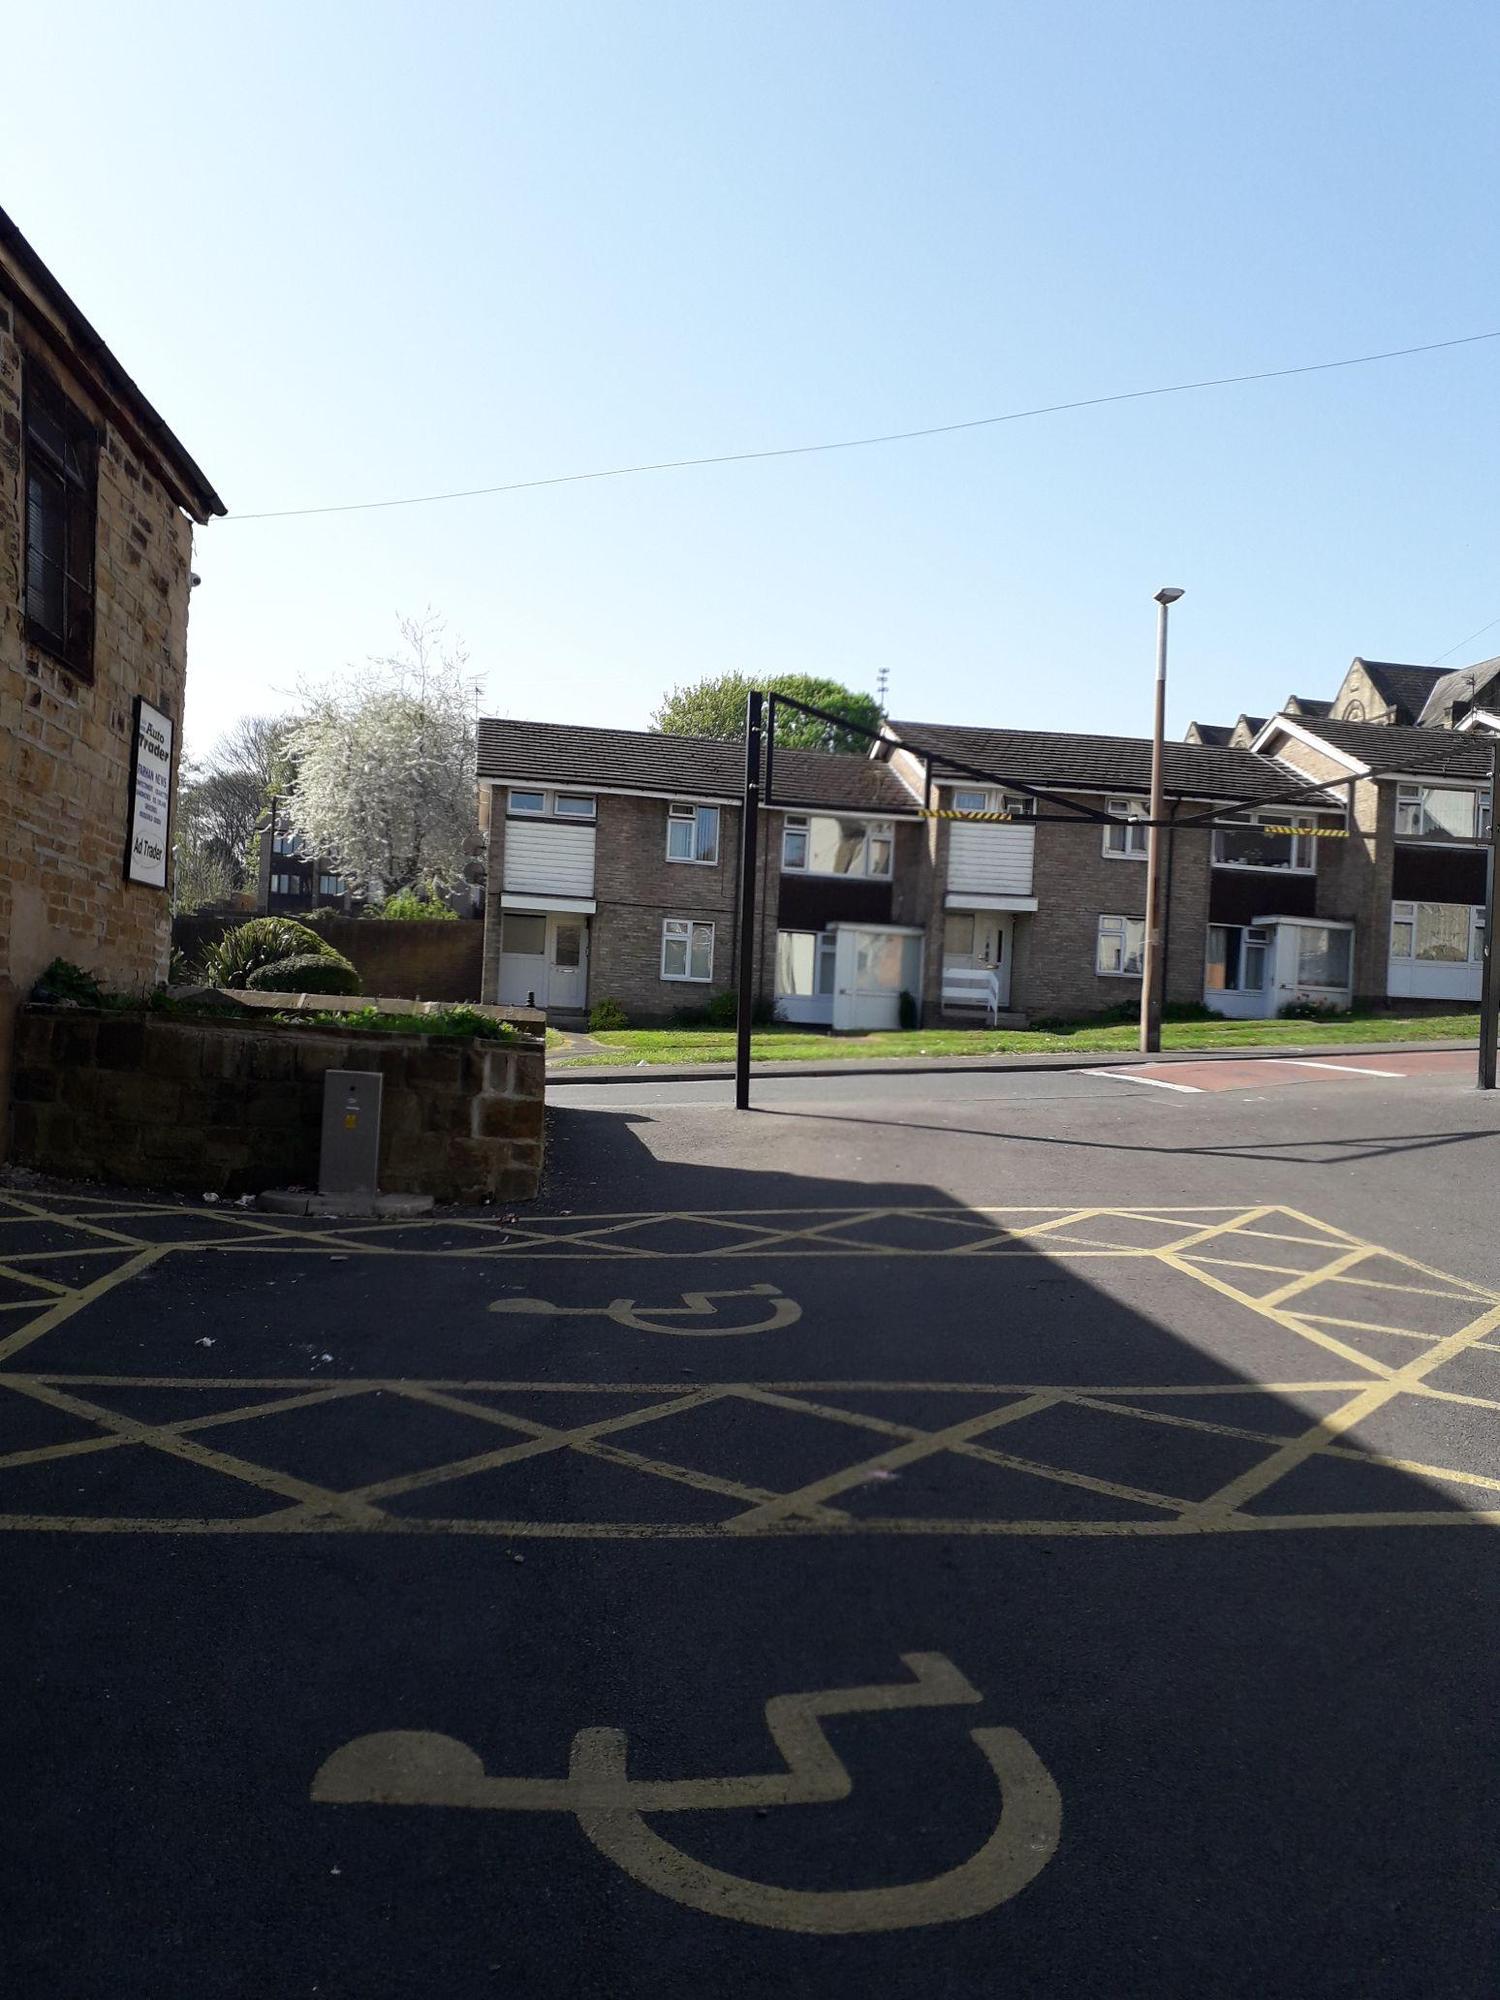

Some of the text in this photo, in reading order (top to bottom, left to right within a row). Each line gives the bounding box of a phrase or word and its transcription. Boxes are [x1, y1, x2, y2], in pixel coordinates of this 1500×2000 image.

[145, 722, 165, 744] Auto
[139, 733, 169, 762] Trader
[134, 836, 162, 861] Ad Trader
